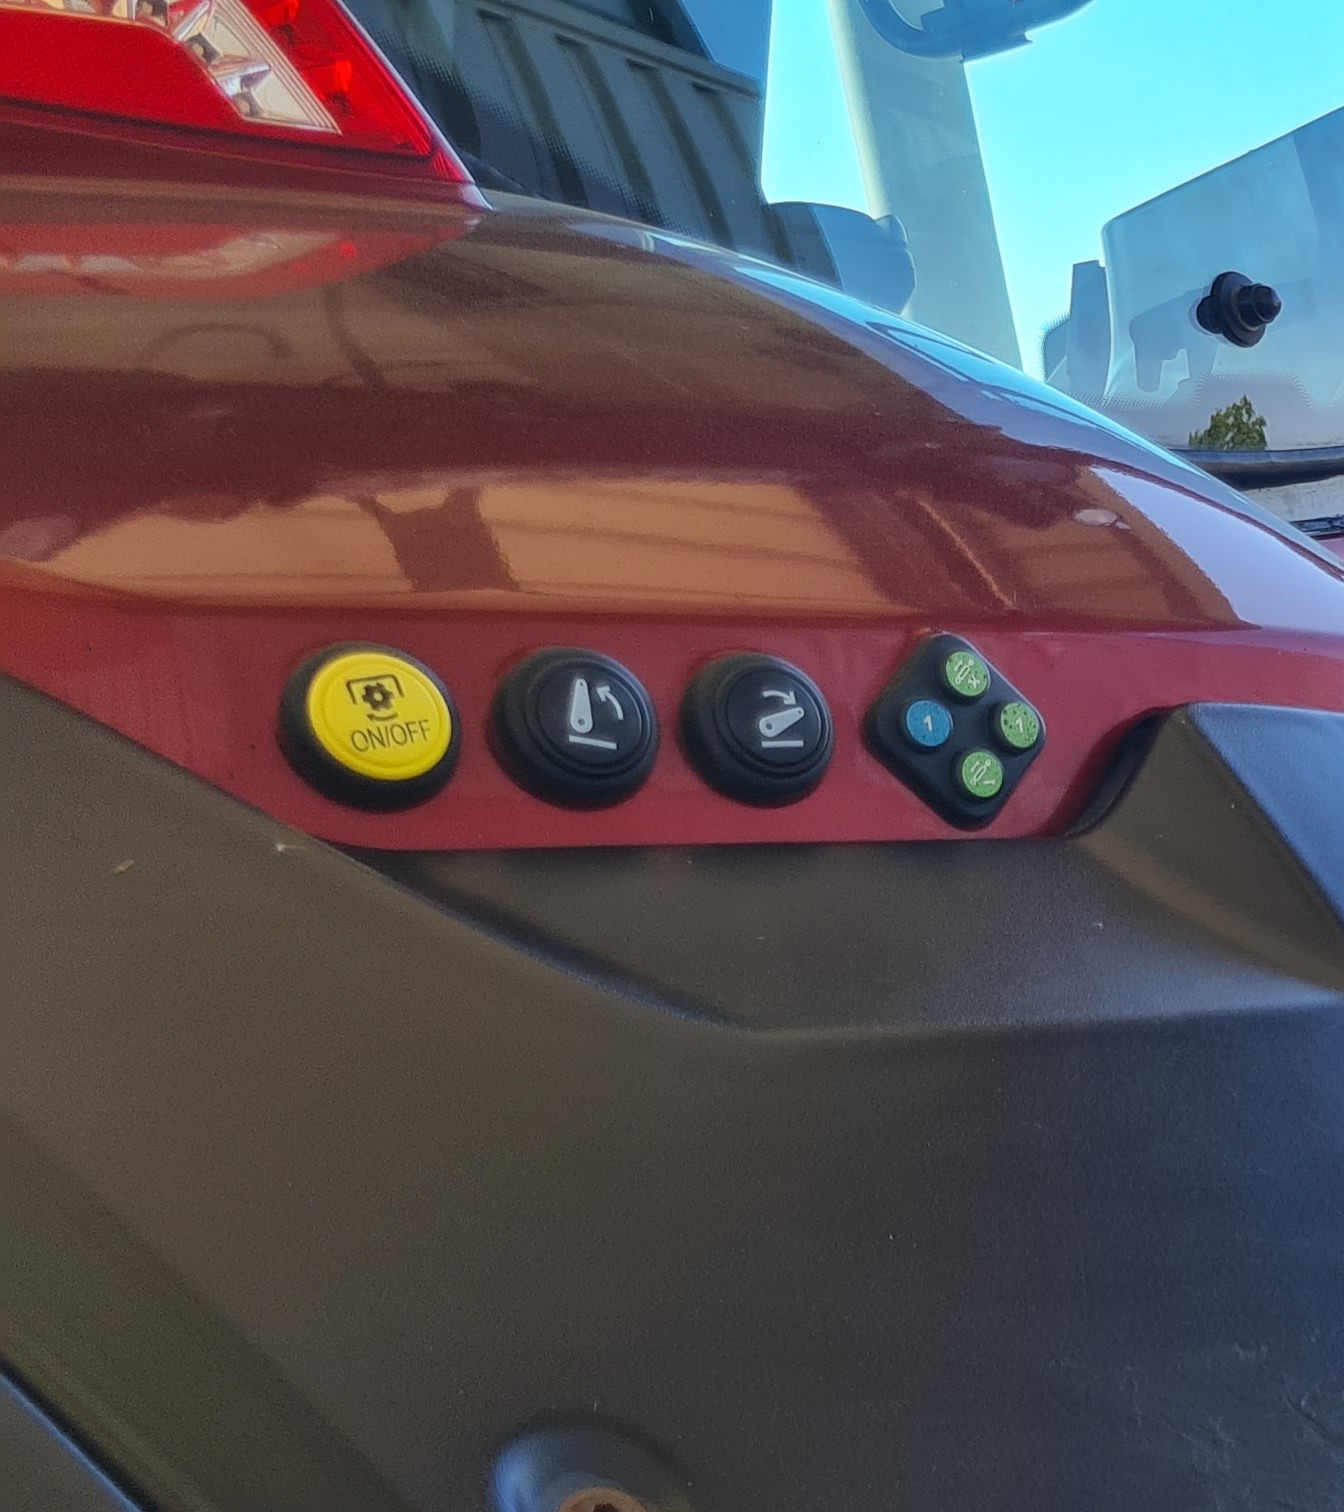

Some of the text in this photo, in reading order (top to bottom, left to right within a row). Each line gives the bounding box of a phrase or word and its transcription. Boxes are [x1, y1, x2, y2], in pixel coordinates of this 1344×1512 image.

[923, 714, 933, 732] 1
[1015, 716, 1024, 733] 1
[351, 719, 431, 753] ON/OFF
